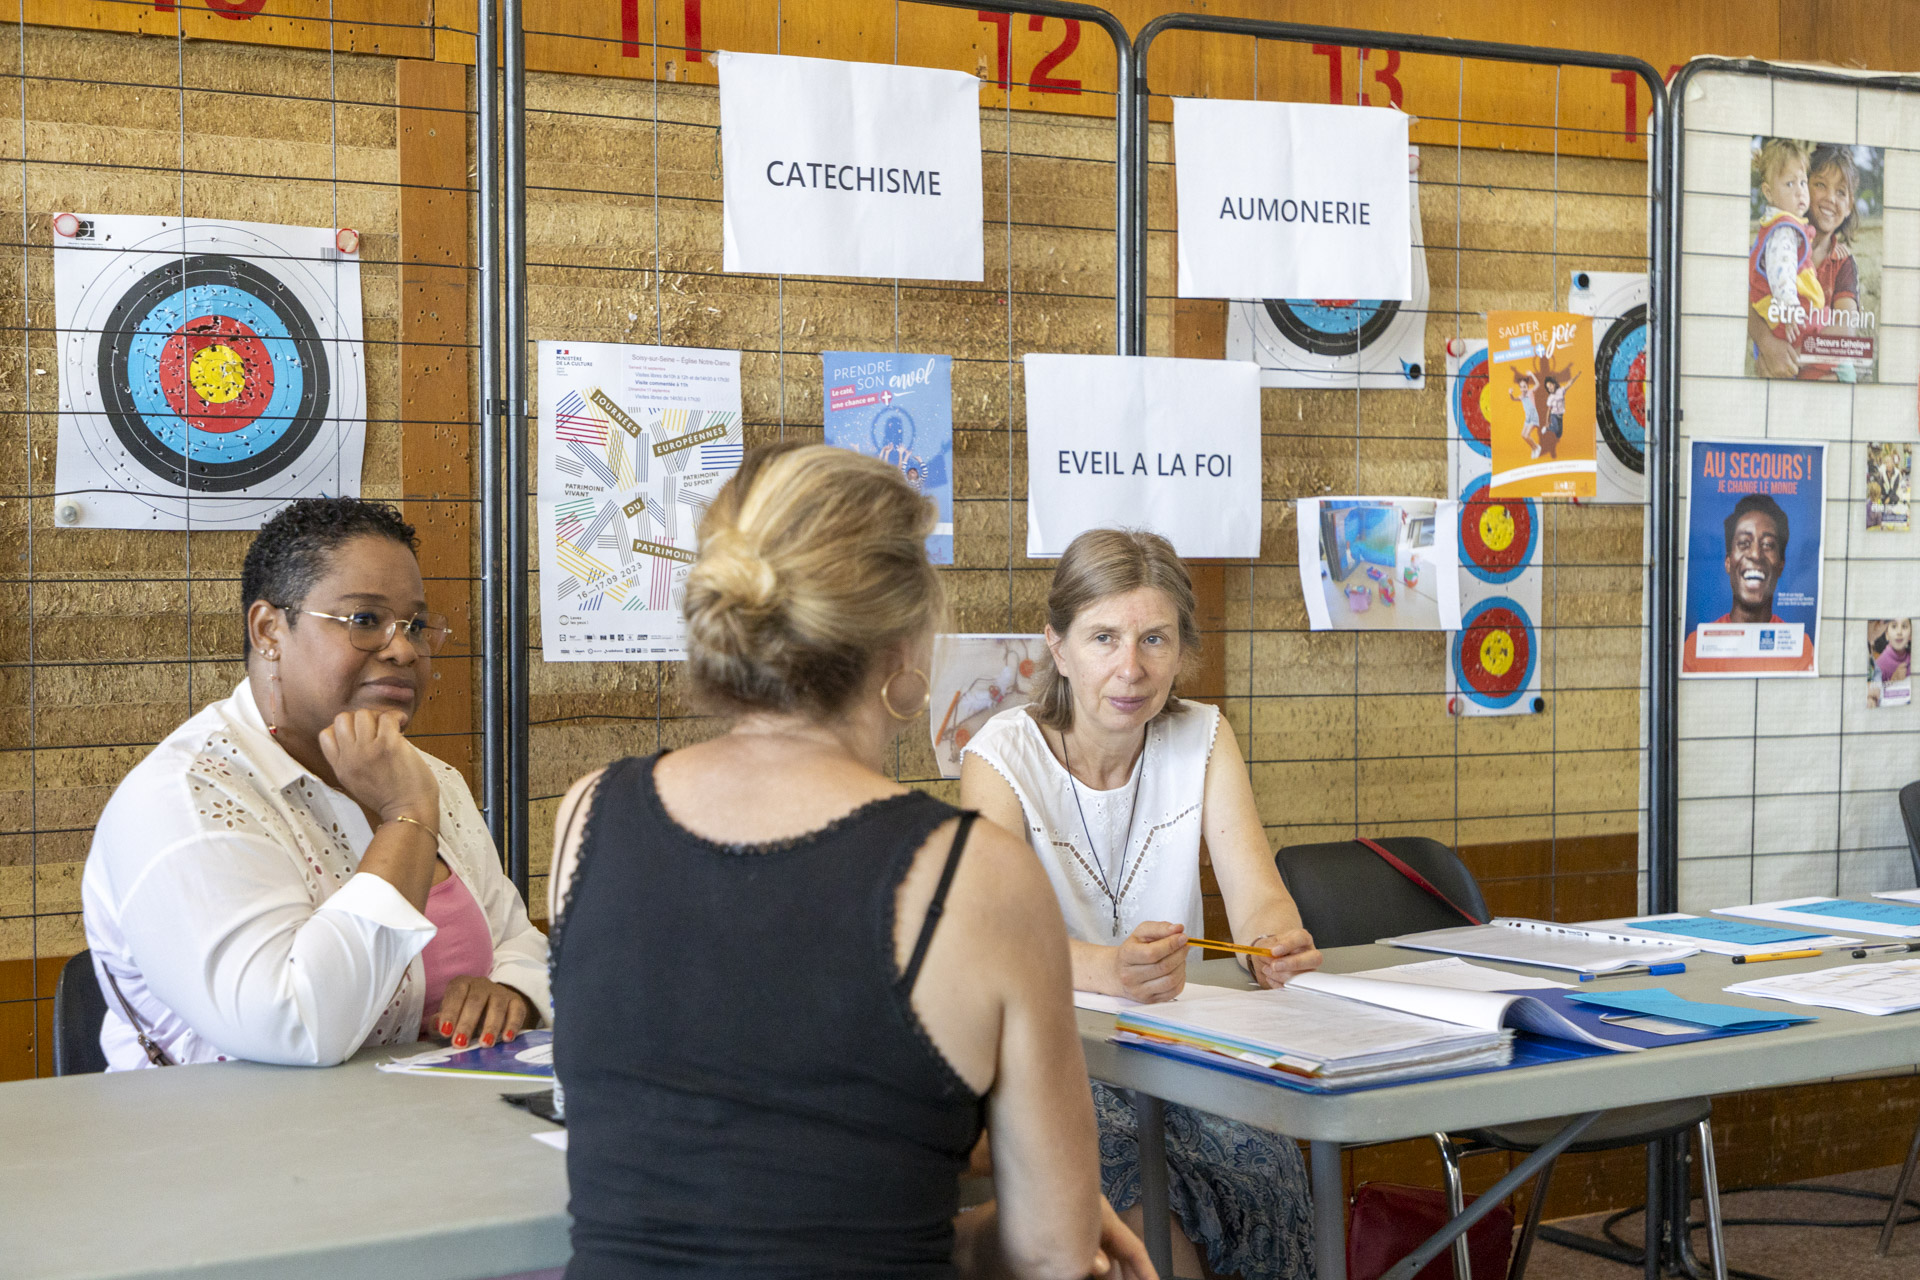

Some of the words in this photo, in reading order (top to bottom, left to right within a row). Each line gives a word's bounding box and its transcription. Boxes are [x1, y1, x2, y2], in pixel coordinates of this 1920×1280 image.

[978, 10, 1082, 95] 12
[1312, 43, 1403, 109] 13
[766, 160, 942, 196] CATECHISME
[1219, 196, 1371, 226] AUMONERIE
[1767, 298, 1805, 325] être
[1808, 301, 1875, 329] humain
[1498, 320, 1540, 339] SAUTER
[1534, 330, 1549, 344] DE
[1545, 322, 1577, 359] joie
[631, 353, 675, 363] Soisy-sur-Seine
[681, 356, 697, 367] Église
[698, 358, 731, 367] Notre-Dame
[834, 360, 893, 381] PRENDRE
[857, 375, 885, 391] SON
[889, 358, 935, 390] envol
[831, 389, 839, 397] Le
[845, 397, 866, 407] chance
[594, 392, 639, 435] JOURNÉES
[656, 426, 724, 454] EUROPÉENNES
[1058, 450, 1124, 475] EVEIL
[1131, 452, 1148, 476] A
[1158, 453, 1186, 477] LA
[1195, 454, 1231, 478] FOI
[1703, 451, 1725, 478] AU
[1729, 451, 1803, 480] SECOURS
[1807, 454, 1811, 480] !
[683, 471, 719, 481] PATRIMOINE
[683, 480, 693, 488] DU
[693, 478, 713, 487] SPORT
[564, 490, 589, 498] VIVANT
[565, 483, 605, 492] PATRIMOINE
[1717, 480, 1726, 493] JE
[1727, 480, 1758, 494] CHANGE
[1760, 480, 1769, 494] LE
[1770, 481, 1798, 495] MONDE
[627, 503, 641, 515] DU
[620, 562, 643, 578] 2023
